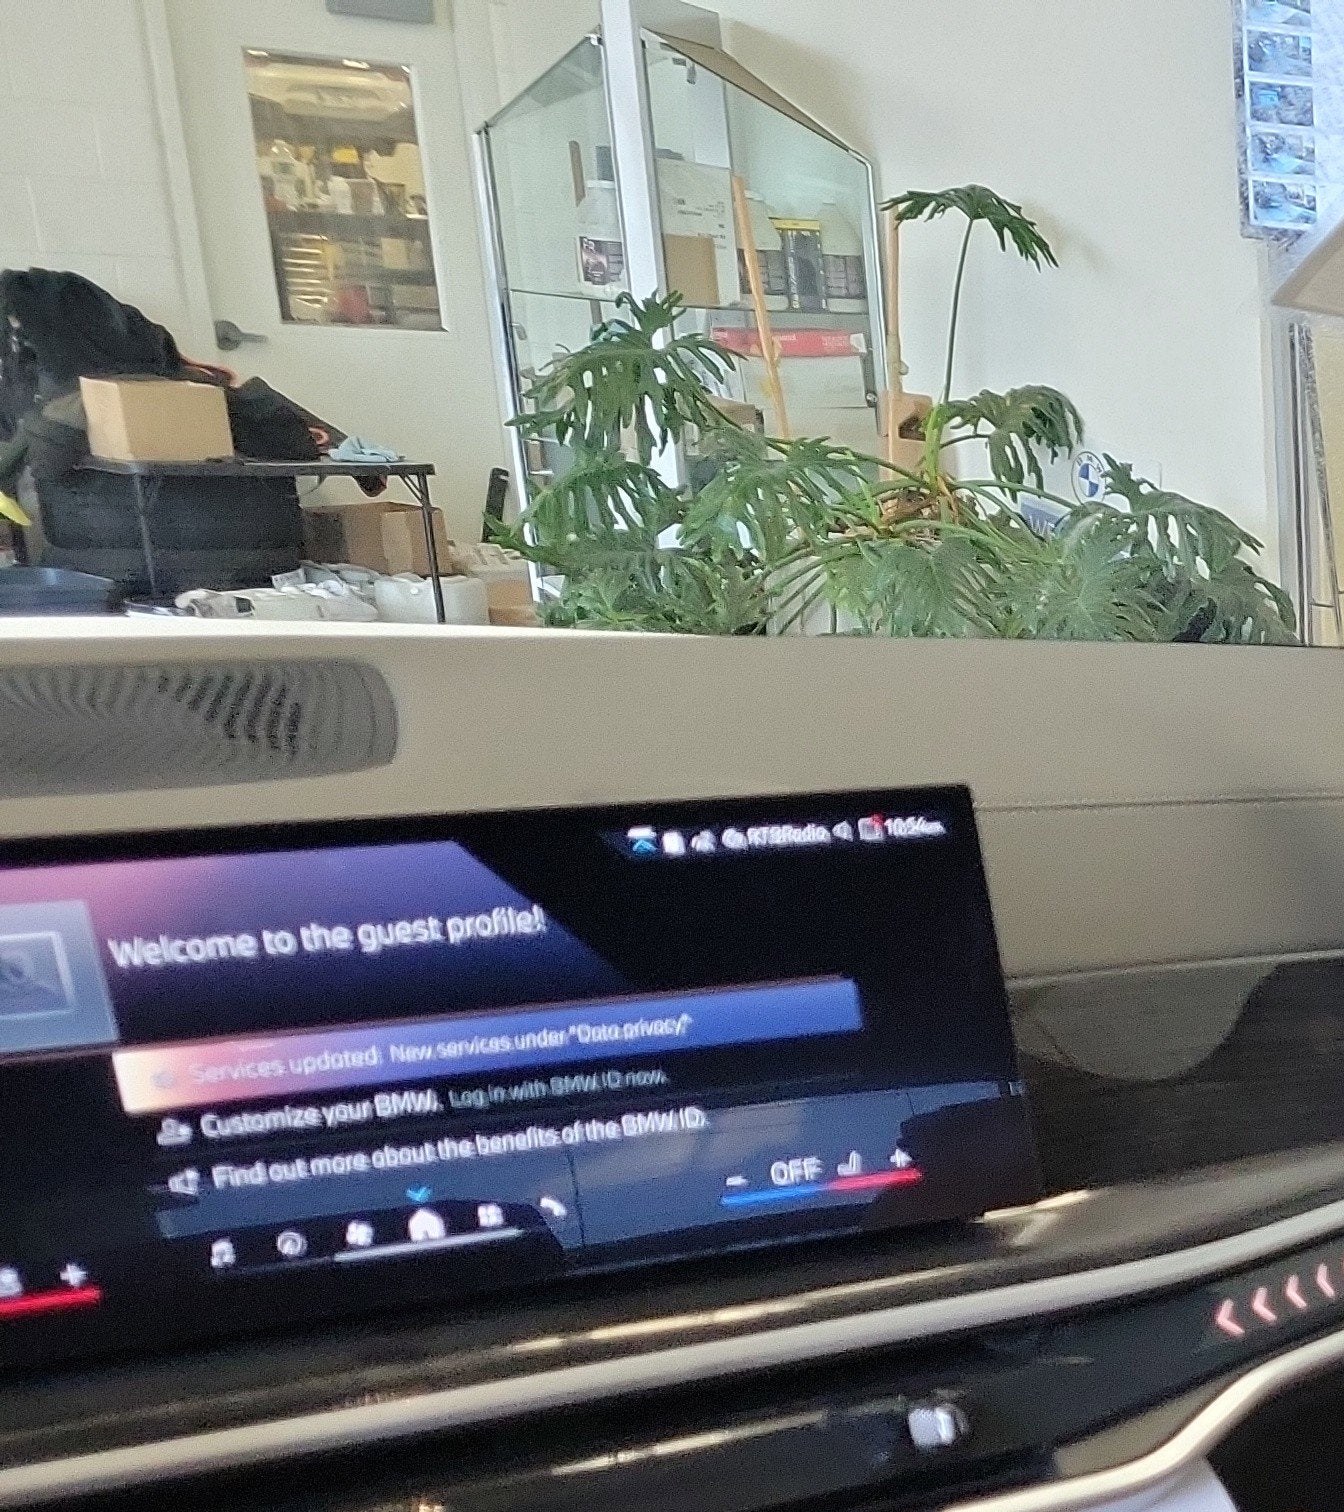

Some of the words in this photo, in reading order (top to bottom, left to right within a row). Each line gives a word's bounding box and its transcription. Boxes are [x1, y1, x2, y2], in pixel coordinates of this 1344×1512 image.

[107, 933, 258, 968] Welcome
[262, 928, 297, 955] to
[300, 920, 354, 952] the
[357, 915, 445, 954] guest
[189, 1058, 286, 1084] Services
[390, 1043, 432, 1062] New
[200, 1104, 322, 1139] Customize
[321, 1099, 373, 1128] your
[448, 1087, 488, 1110] Log
[211, 1160, 269, 1189] Find
[269, 1158, 308, 1182] out
[310, 1150, 371, 1177] more
[372, 1142, 438, 1170] about
[437, 1136, 477, 1162] the
[475, 1125, 561, 1156] benefits
[561, 1120, 586, 1145] of
[585, 1117, 622, 1142] the
[770, 1155, 823, 1187] OFF
